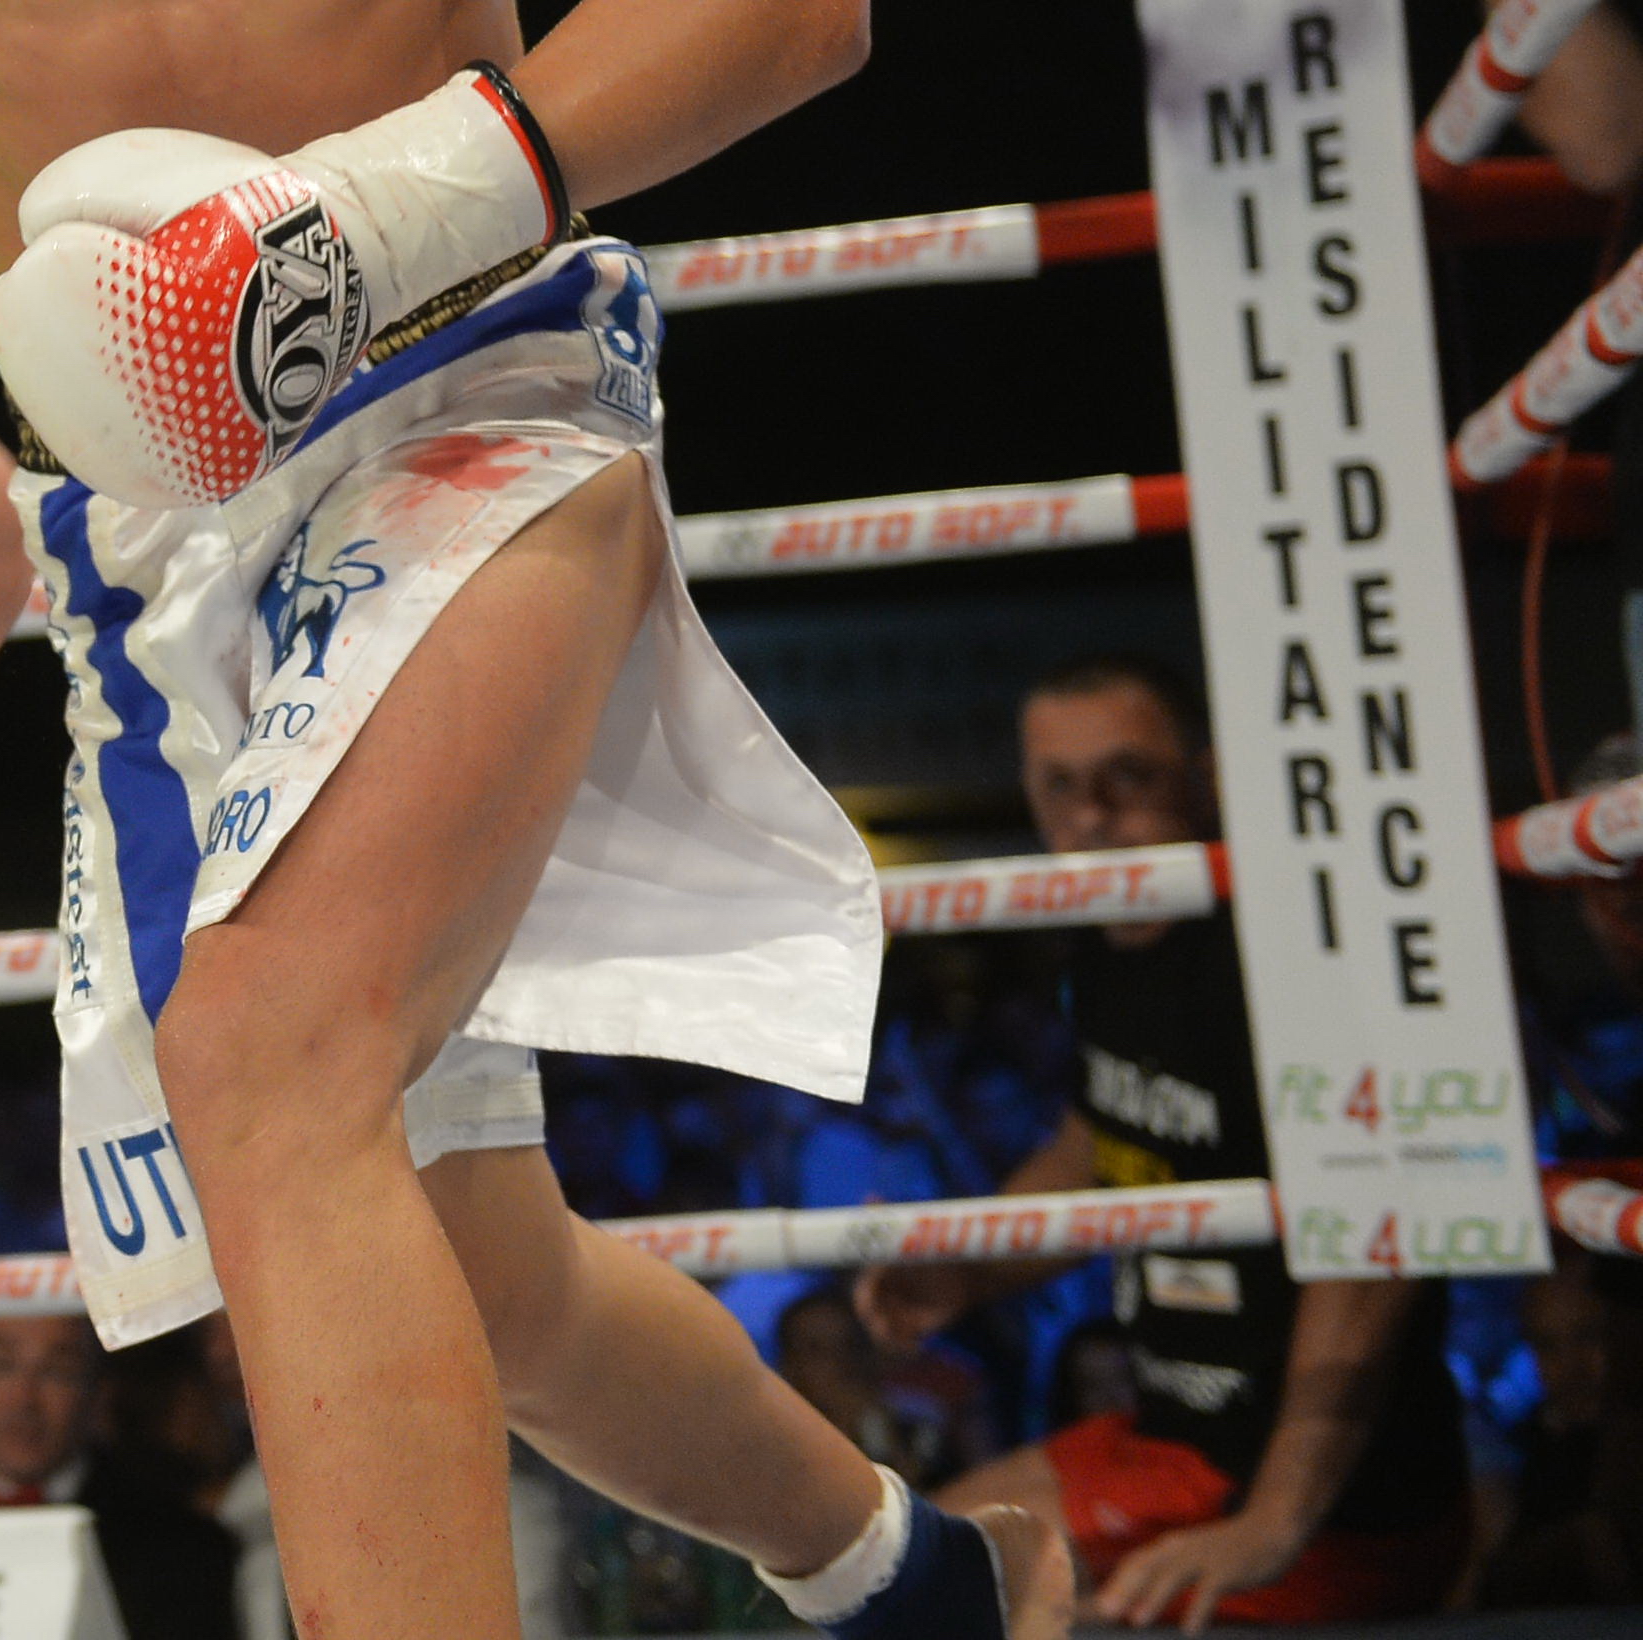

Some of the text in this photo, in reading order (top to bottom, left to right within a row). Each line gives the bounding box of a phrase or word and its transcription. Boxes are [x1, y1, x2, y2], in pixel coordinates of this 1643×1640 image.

[881, 876, 988, 930] UTO
[1206, 81, 1341, 952] MILITARI
[1289, 13, 1443, 1008] RESIDENCE
